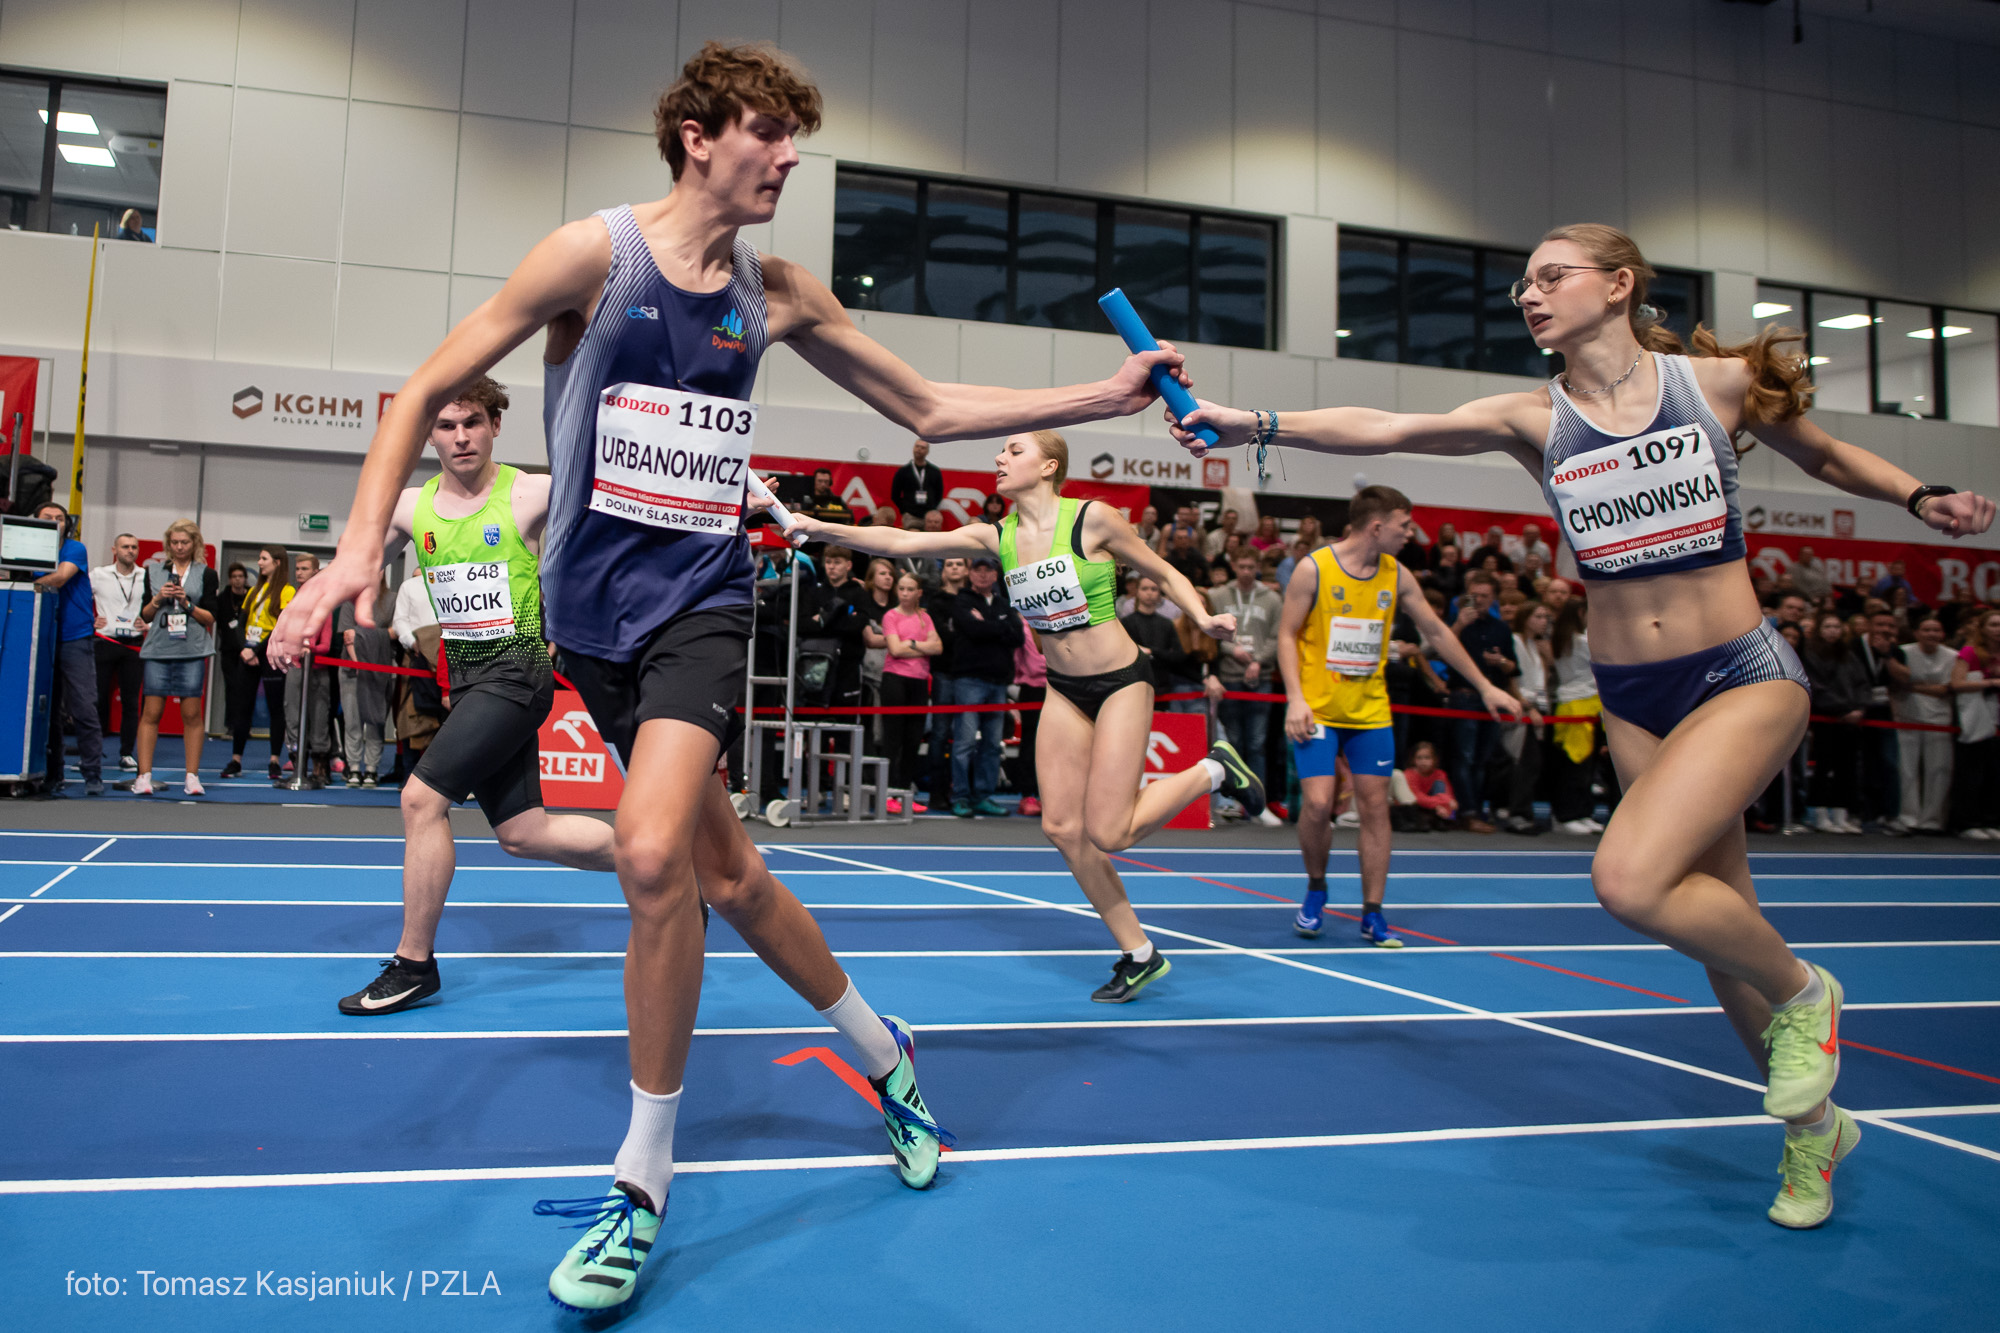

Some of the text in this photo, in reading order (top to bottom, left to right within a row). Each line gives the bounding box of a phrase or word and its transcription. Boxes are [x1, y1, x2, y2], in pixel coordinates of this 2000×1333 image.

[627, 306, 659, 320] esa
[712, 335, 747, 353] Dywity
[274, 392, 363, 419] KGHM
[605, 395, 752, 435] BODZIO 1103
[273, 416, 319, 425] POLSKA
[602, 435, 743, 487] URBANOWICZ
[1123, 458, 1191, 480] KGHM
[1554, 430, 1700, 486] BODZIO 1097
[598, 482, 613, 492] PZLA
[613, 487, 637, 499] Halowe
[638, 492, 682, 507] Mistrzostwa
[683, 499, 705, 511] Polski
[705, 503, 717, 512] U18
[722, 506, 737, 514] U20
[1569, 474, 1721, 534] CHOJNOWSKA
[605, 498, 722, 529] DOLNY ŚLĄSK 2024
[1580, 550, 1596, 559] PZLA
[1597, 543, 1625, 556] Halowe
[1626, 532, 1673, 549] Mistrzostwa
[1674, 526, 1697, 538] Polski
[1698, 522, 1712, 532] U18
[1594, 532, 1724, 571] DOLNY ŚLĄSK 2024
[467, 564, 499, 581] 648
[1036, 560, 1066, 580] 650
[437, 591, 503, 614] WÓJCIK
[1015, 585, 1074, 611] ZAWÓŁ
[1068, 614, 1086, 624] 2024
[485, 628, 505, 637] 2024
